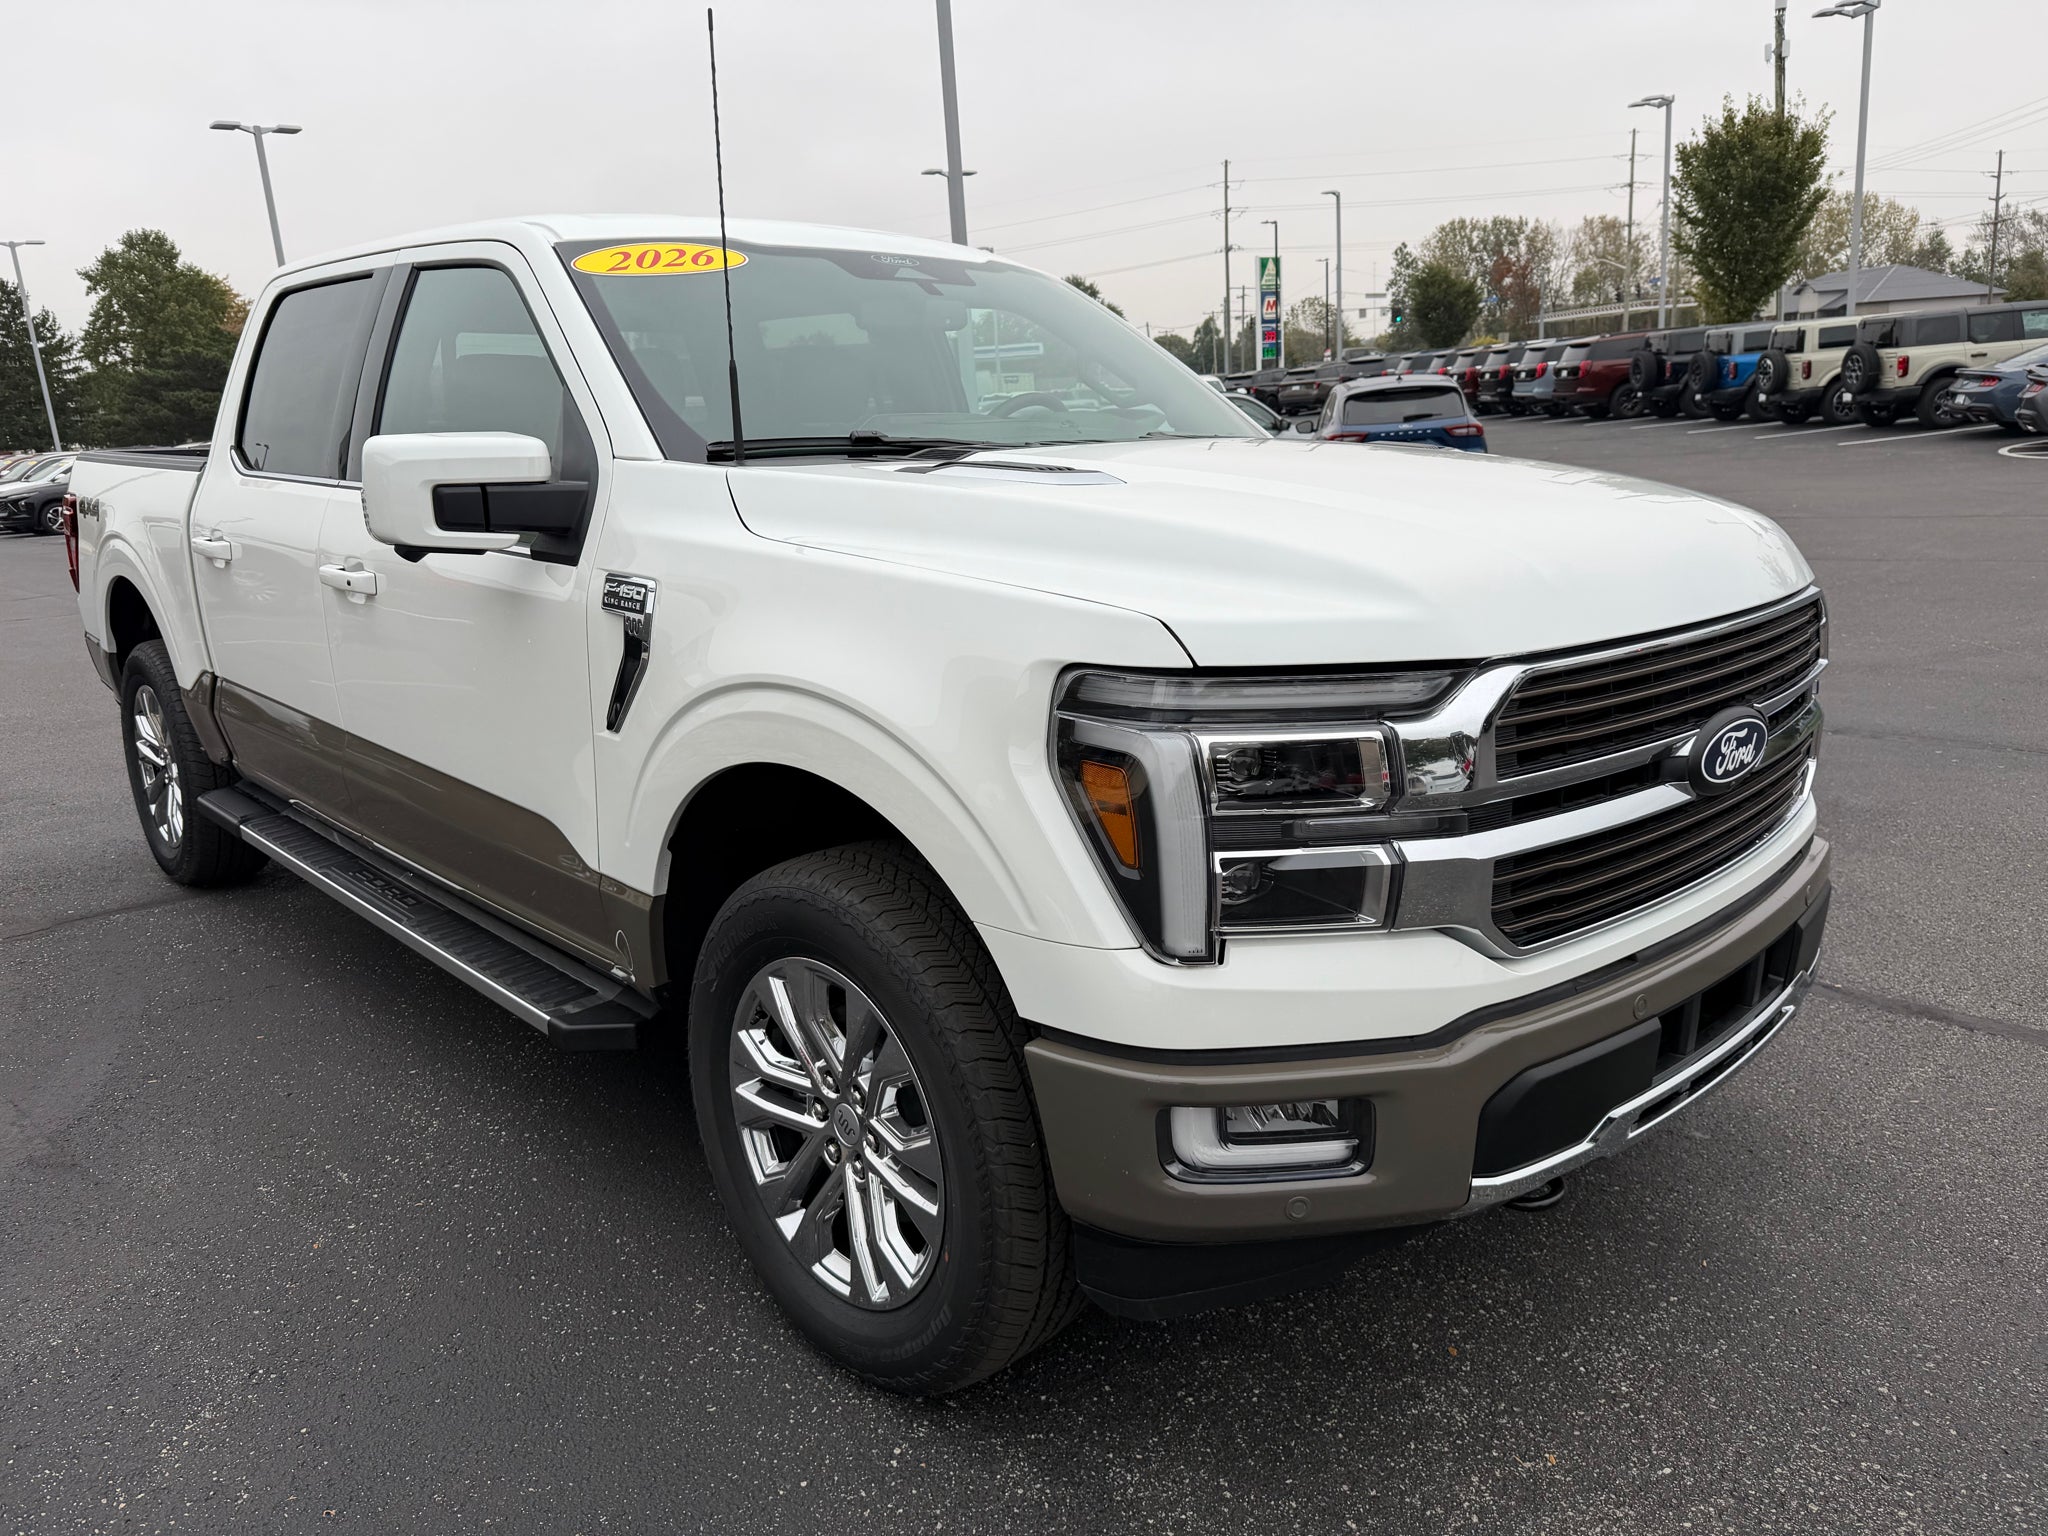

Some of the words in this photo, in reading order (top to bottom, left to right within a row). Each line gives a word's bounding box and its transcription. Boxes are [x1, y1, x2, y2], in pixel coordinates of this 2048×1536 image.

[606, 247, 717, 273] 2026
[79, 496, 100, 522] 4x4
[604, 582, 646, 601] F-150
[1715, 727, 1758, 776] Ford
